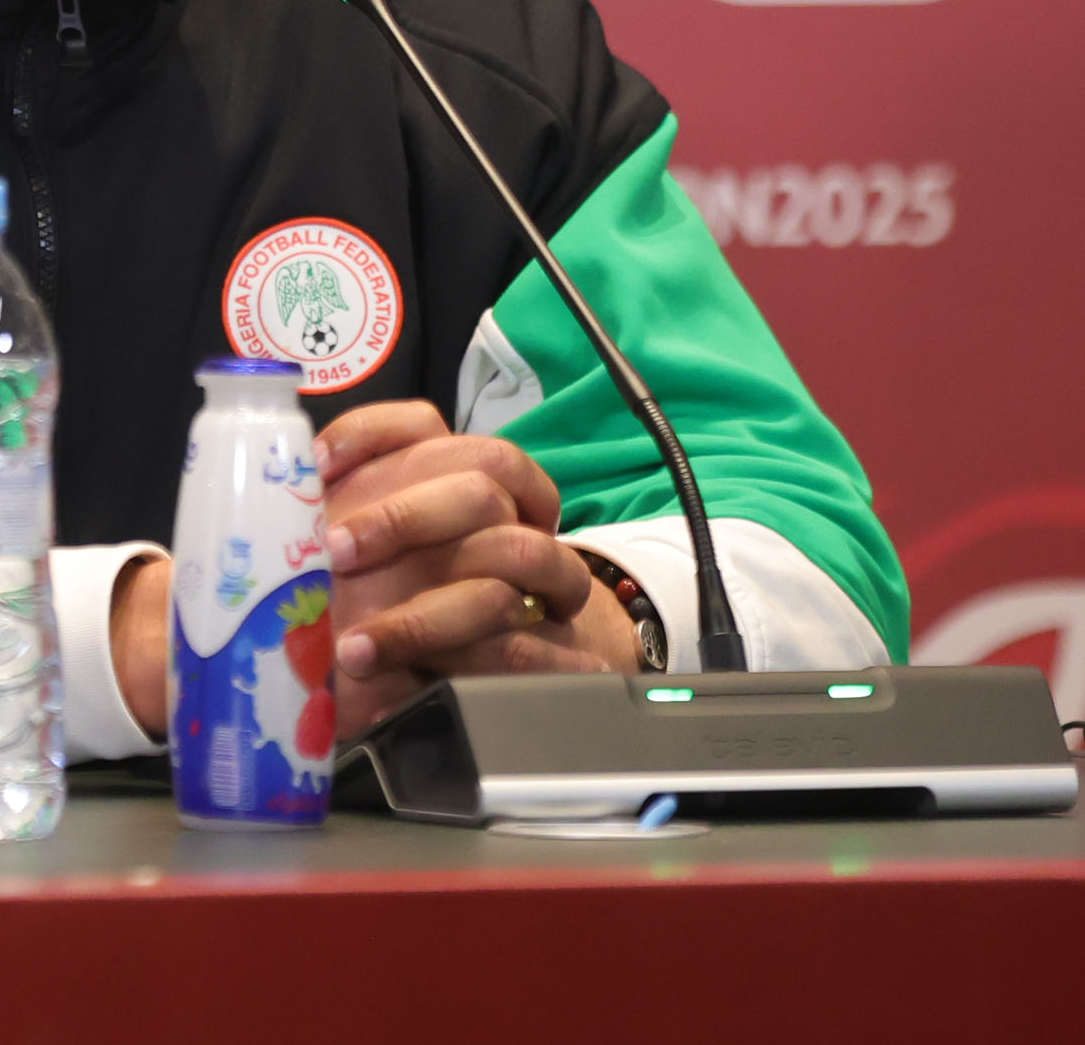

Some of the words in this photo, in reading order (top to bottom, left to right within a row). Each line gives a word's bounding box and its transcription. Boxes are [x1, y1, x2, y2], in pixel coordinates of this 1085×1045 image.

[238, 229, 328, 291] FOOTBALL
[333, 235, 391, 350] FEDERATION
[308, 361, 352, 384] 1945
